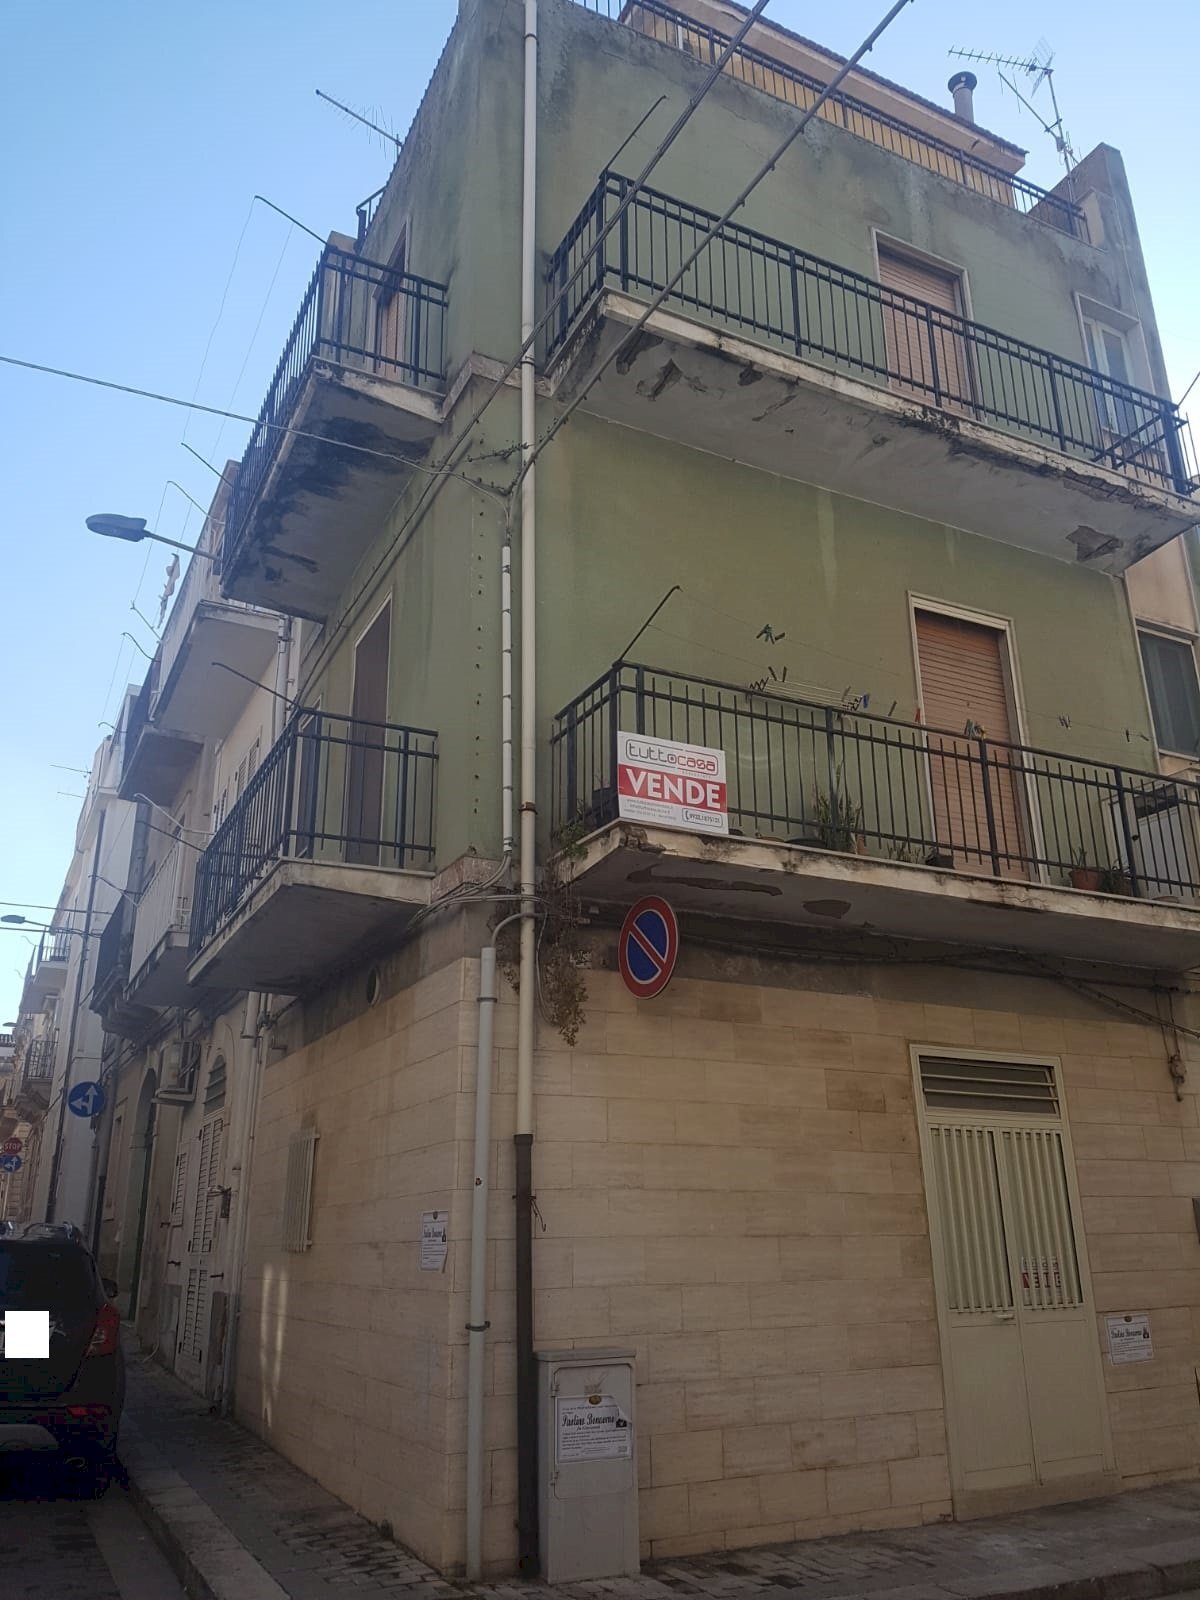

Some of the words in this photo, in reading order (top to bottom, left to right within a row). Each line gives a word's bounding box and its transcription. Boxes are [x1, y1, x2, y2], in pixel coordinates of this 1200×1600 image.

[628, 743, 716, 772] tuttocasa
[626, 768, 721, 809] VENDE
[5, 1142, 20, 1150] STOP
